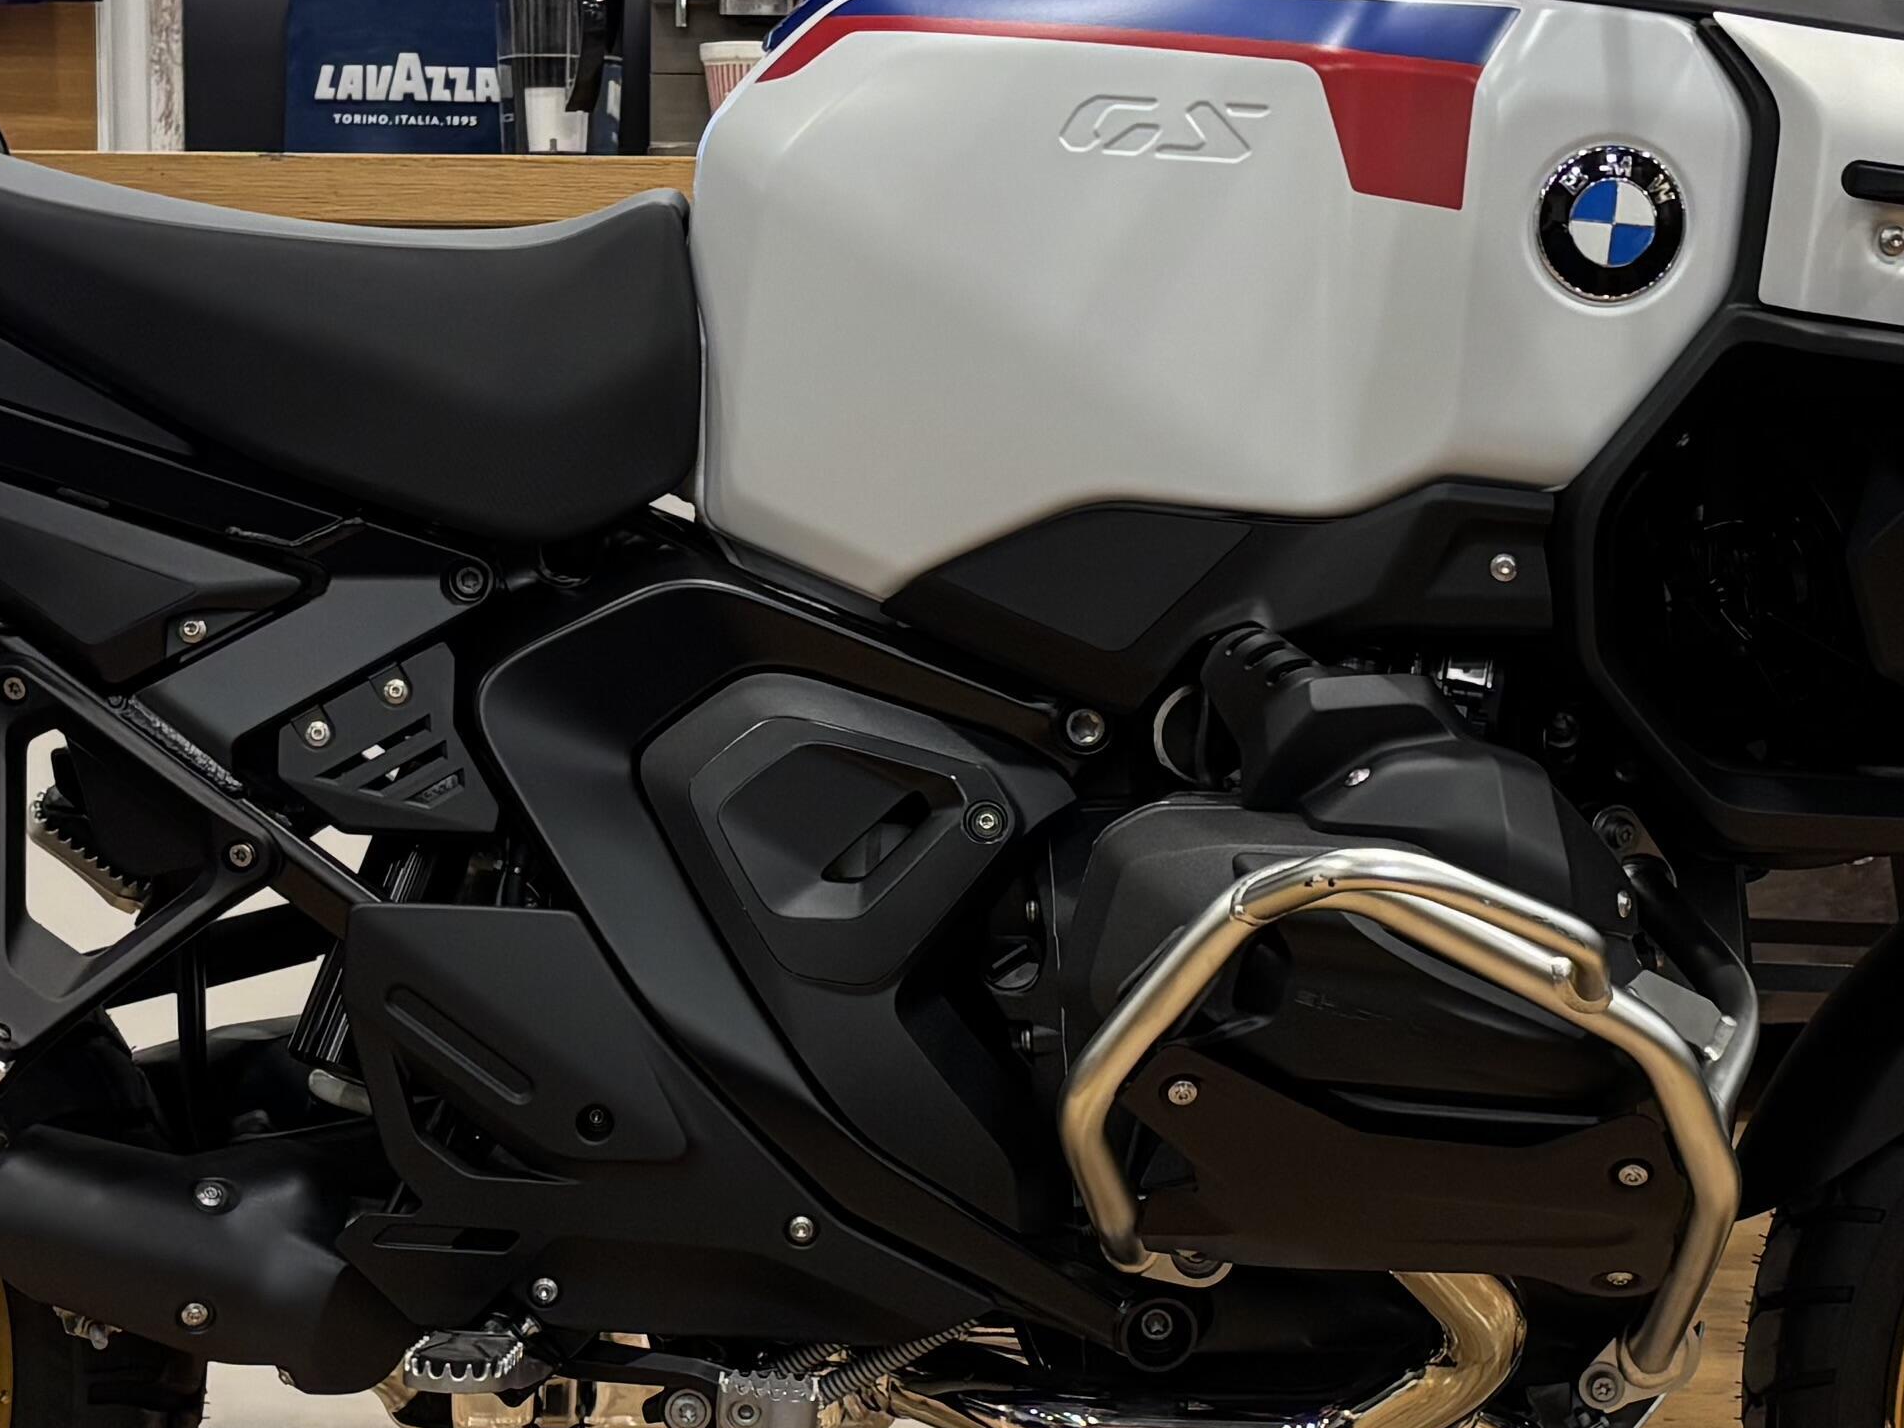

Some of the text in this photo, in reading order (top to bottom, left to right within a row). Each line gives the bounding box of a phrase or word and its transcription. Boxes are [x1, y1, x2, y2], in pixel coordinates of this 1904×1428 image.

[314, 52, 506, 103] LAVAZZA
[446, 115, 478, 127] 1895
[1059, 93, 1271, 164] GS
[1559, 153, 1676, 204] BMW
